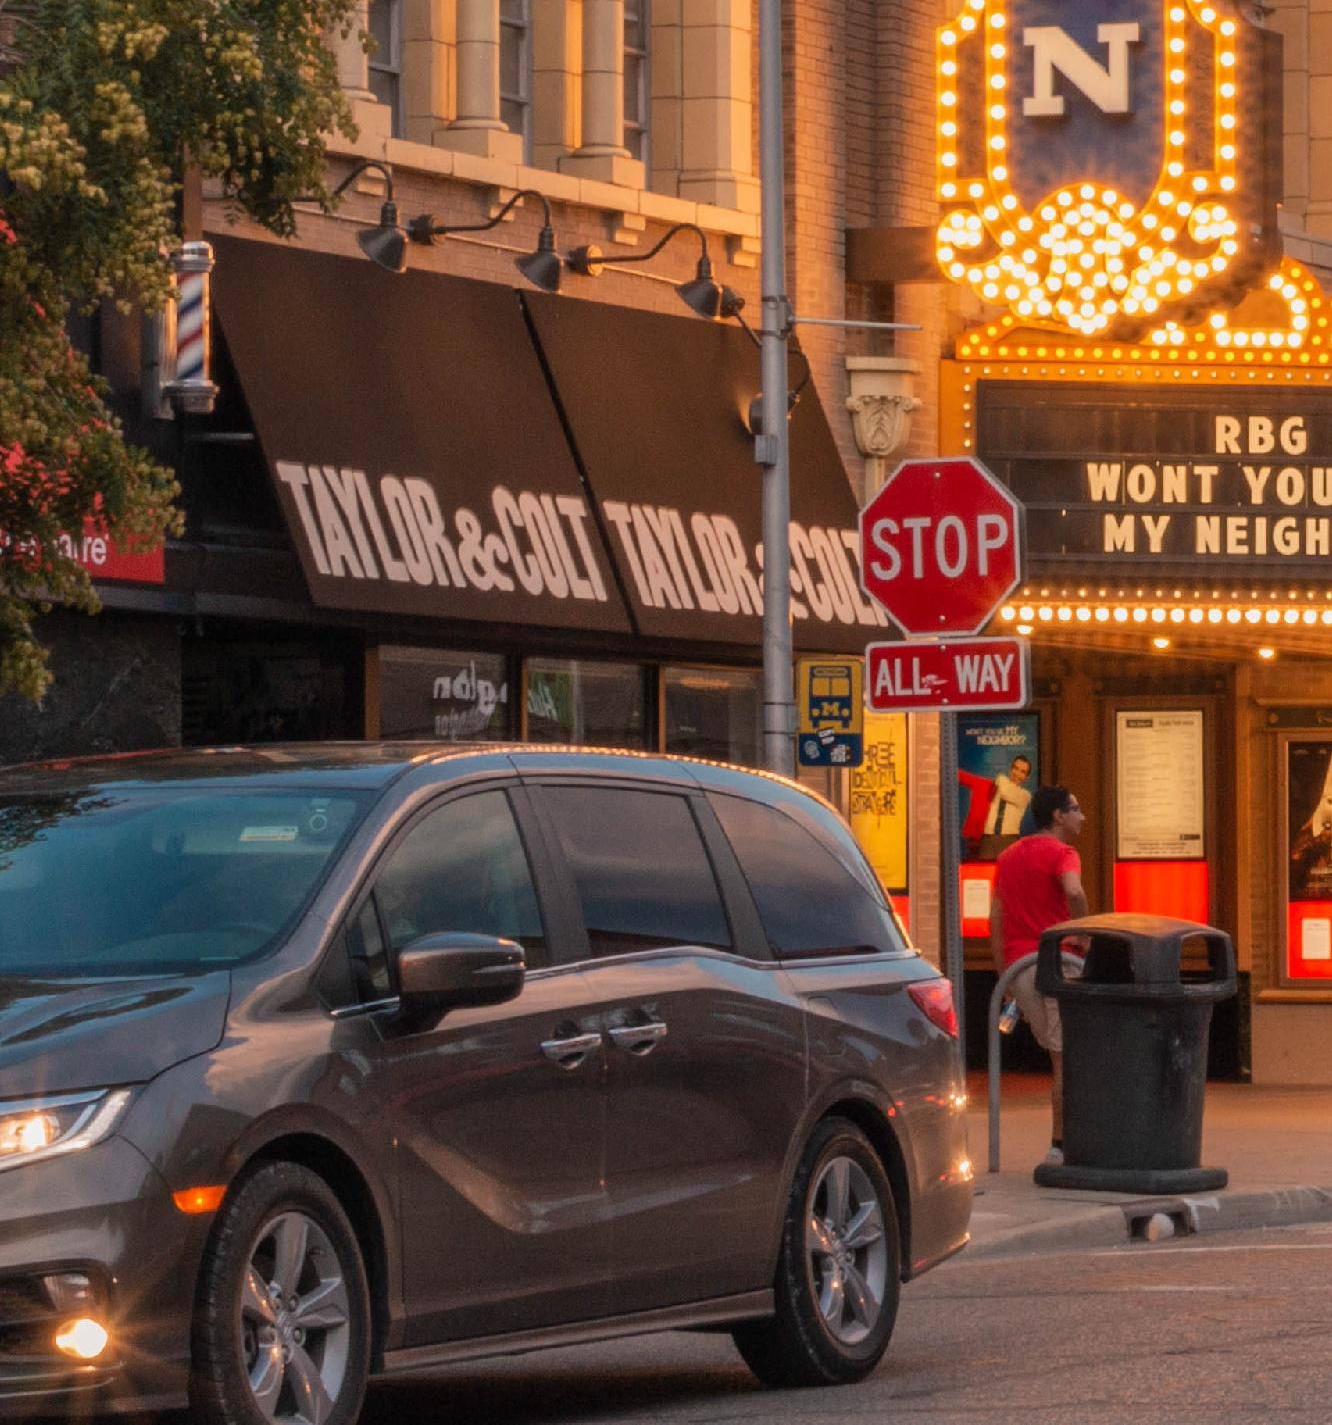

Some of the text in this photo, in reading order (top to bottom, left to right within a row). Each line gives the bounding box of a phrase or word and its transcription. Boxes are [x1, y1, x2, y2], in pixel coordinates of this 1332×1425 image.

[1215, 416, 1307, 454] RBG
[1087, 464, 1218, 503] WONT
[870, 514, 1009, 581] STOP
[1103, 514, 1170, 553] MY
[875, 654, 1015, 696] ALL WAY
